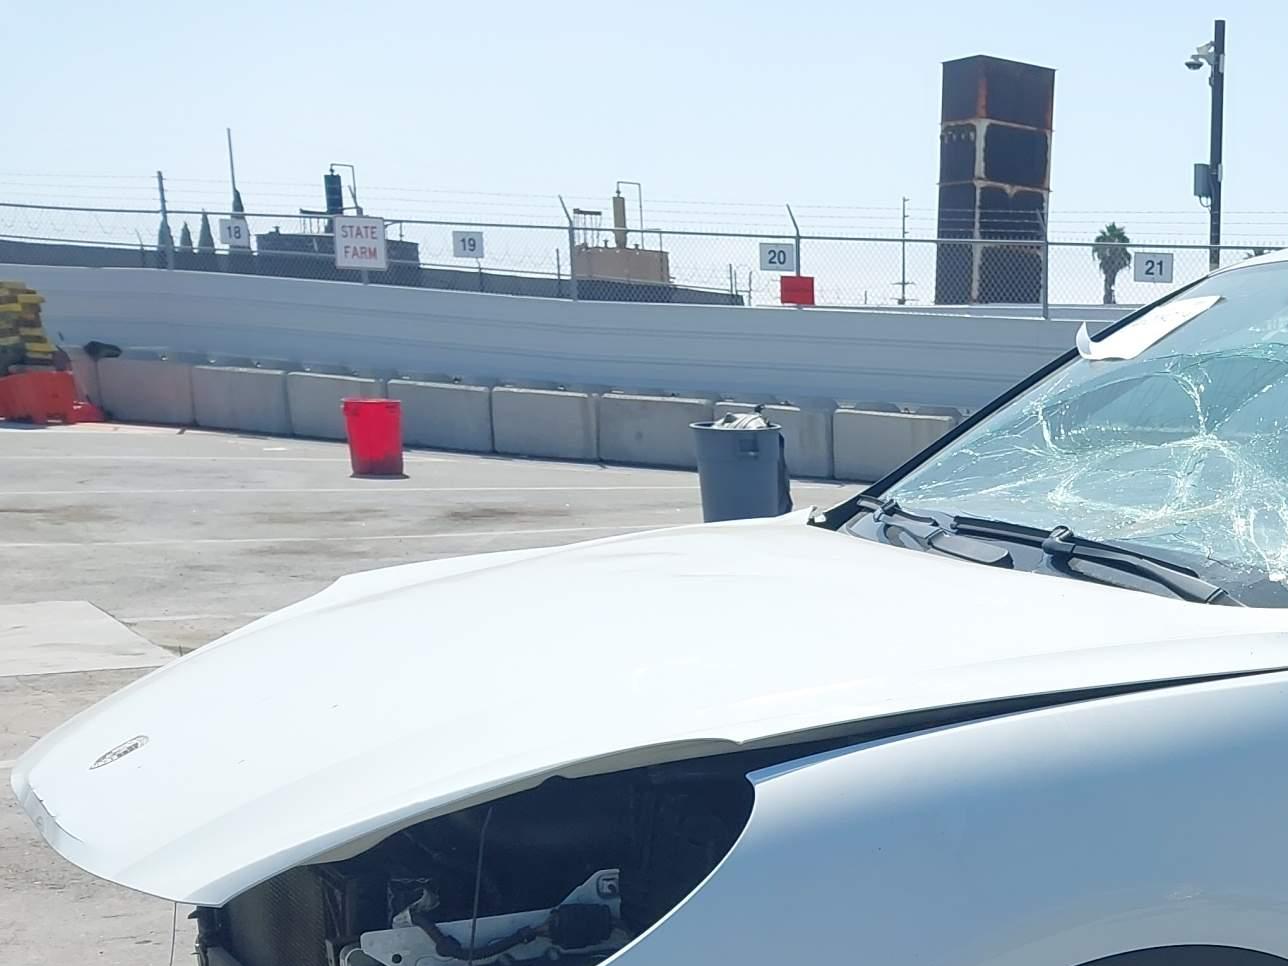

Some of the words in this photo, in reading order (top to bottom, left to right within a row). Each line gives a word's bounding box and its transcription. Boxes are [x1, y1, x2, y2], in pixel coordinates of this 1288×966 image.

[226, 225, 241, 240] 18
[341, 225, 377, 240] STATE
[344, 245, 377, 259] FARM
[460, 237, 476, 252] 19
[767, 249, 786, 265] 20
[1144, 259, 1163, 276] 21
